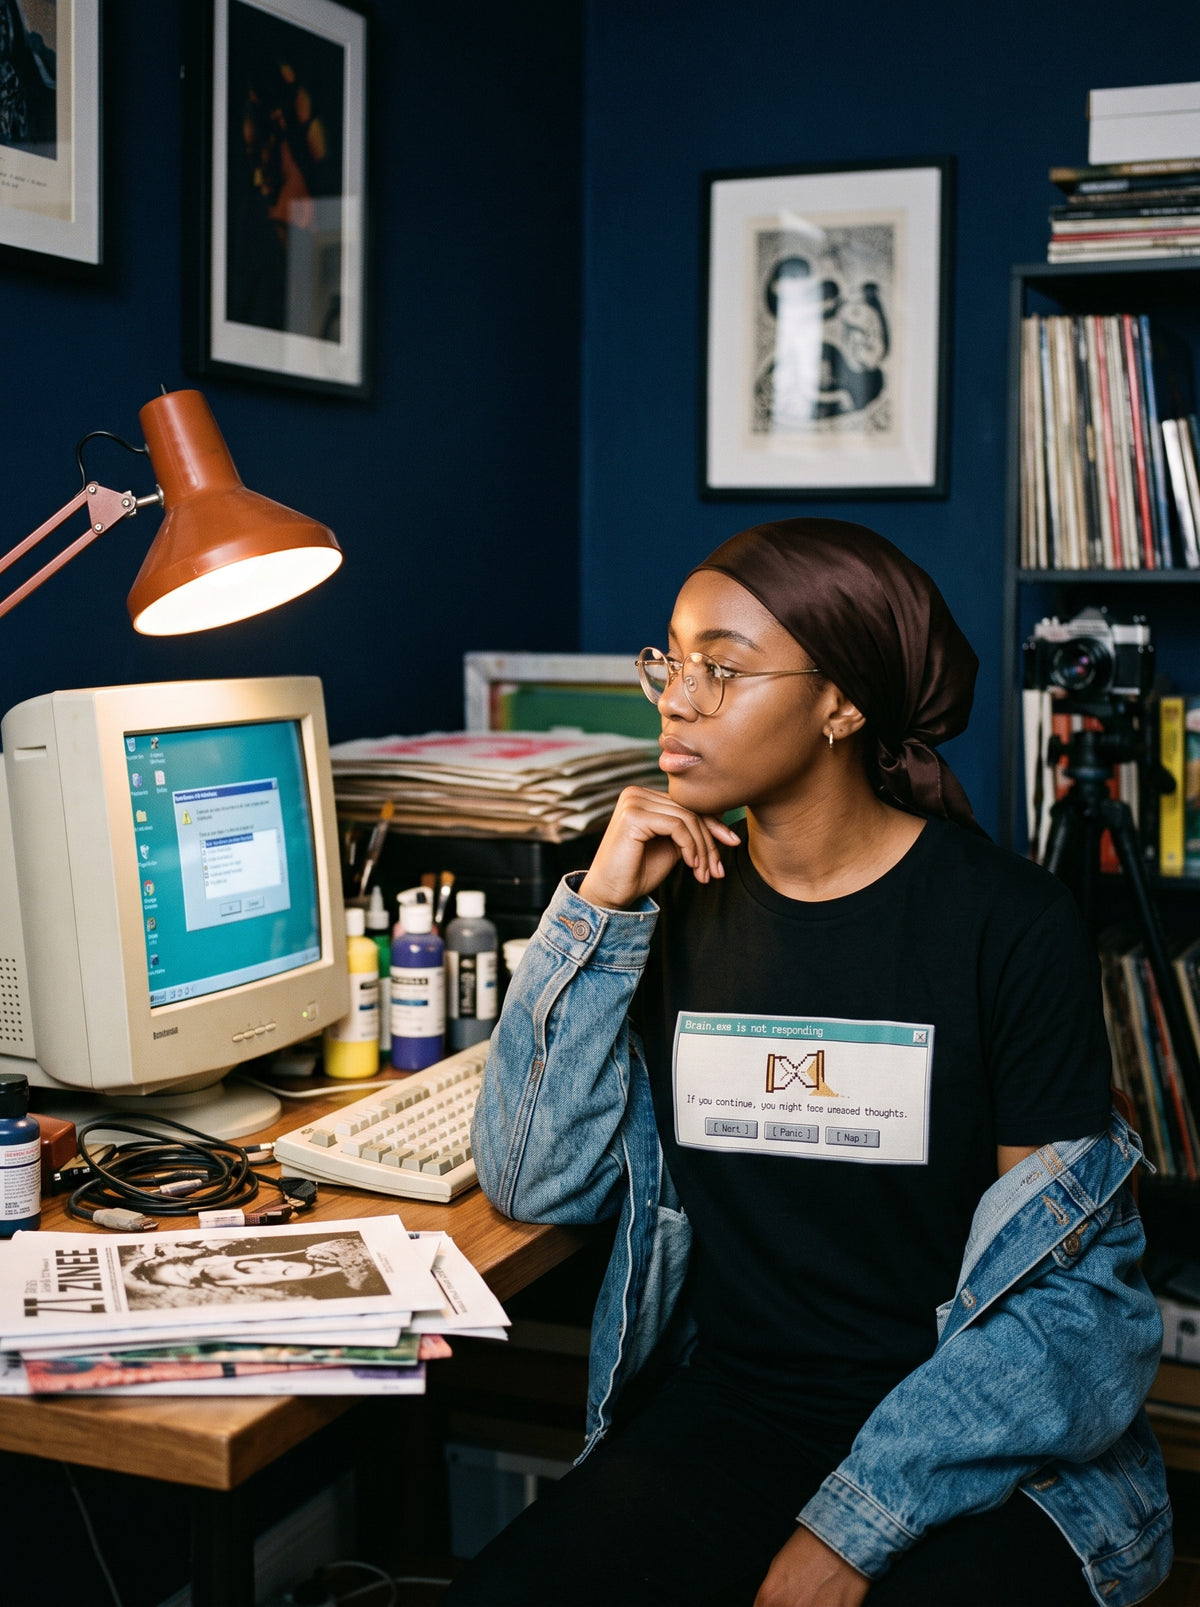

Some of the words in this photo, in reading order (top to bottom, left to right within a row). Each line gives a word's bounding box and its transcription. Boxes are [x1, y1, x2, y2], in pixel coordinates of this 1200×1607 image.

[685, 1020, 732, 1031] Brain.exe
[736, 1022, 747, 1032] is
[751, 1024, 767, 1033] not
[772, 1025, 824, 1037] responding
[687, 1094, 695, 1103] If
[698, 1098, 713, 1106] you
[716, 1098, 756, 1109] continue,
[761, 1102, 776, 1111] you
[865, 1107, 908, 1119] thoughts.
[780, 1127, 803, 1138] Panic
[844, 1133, 860, 1143] Nap
[55, 1247, 103, 1293] ZINEE
